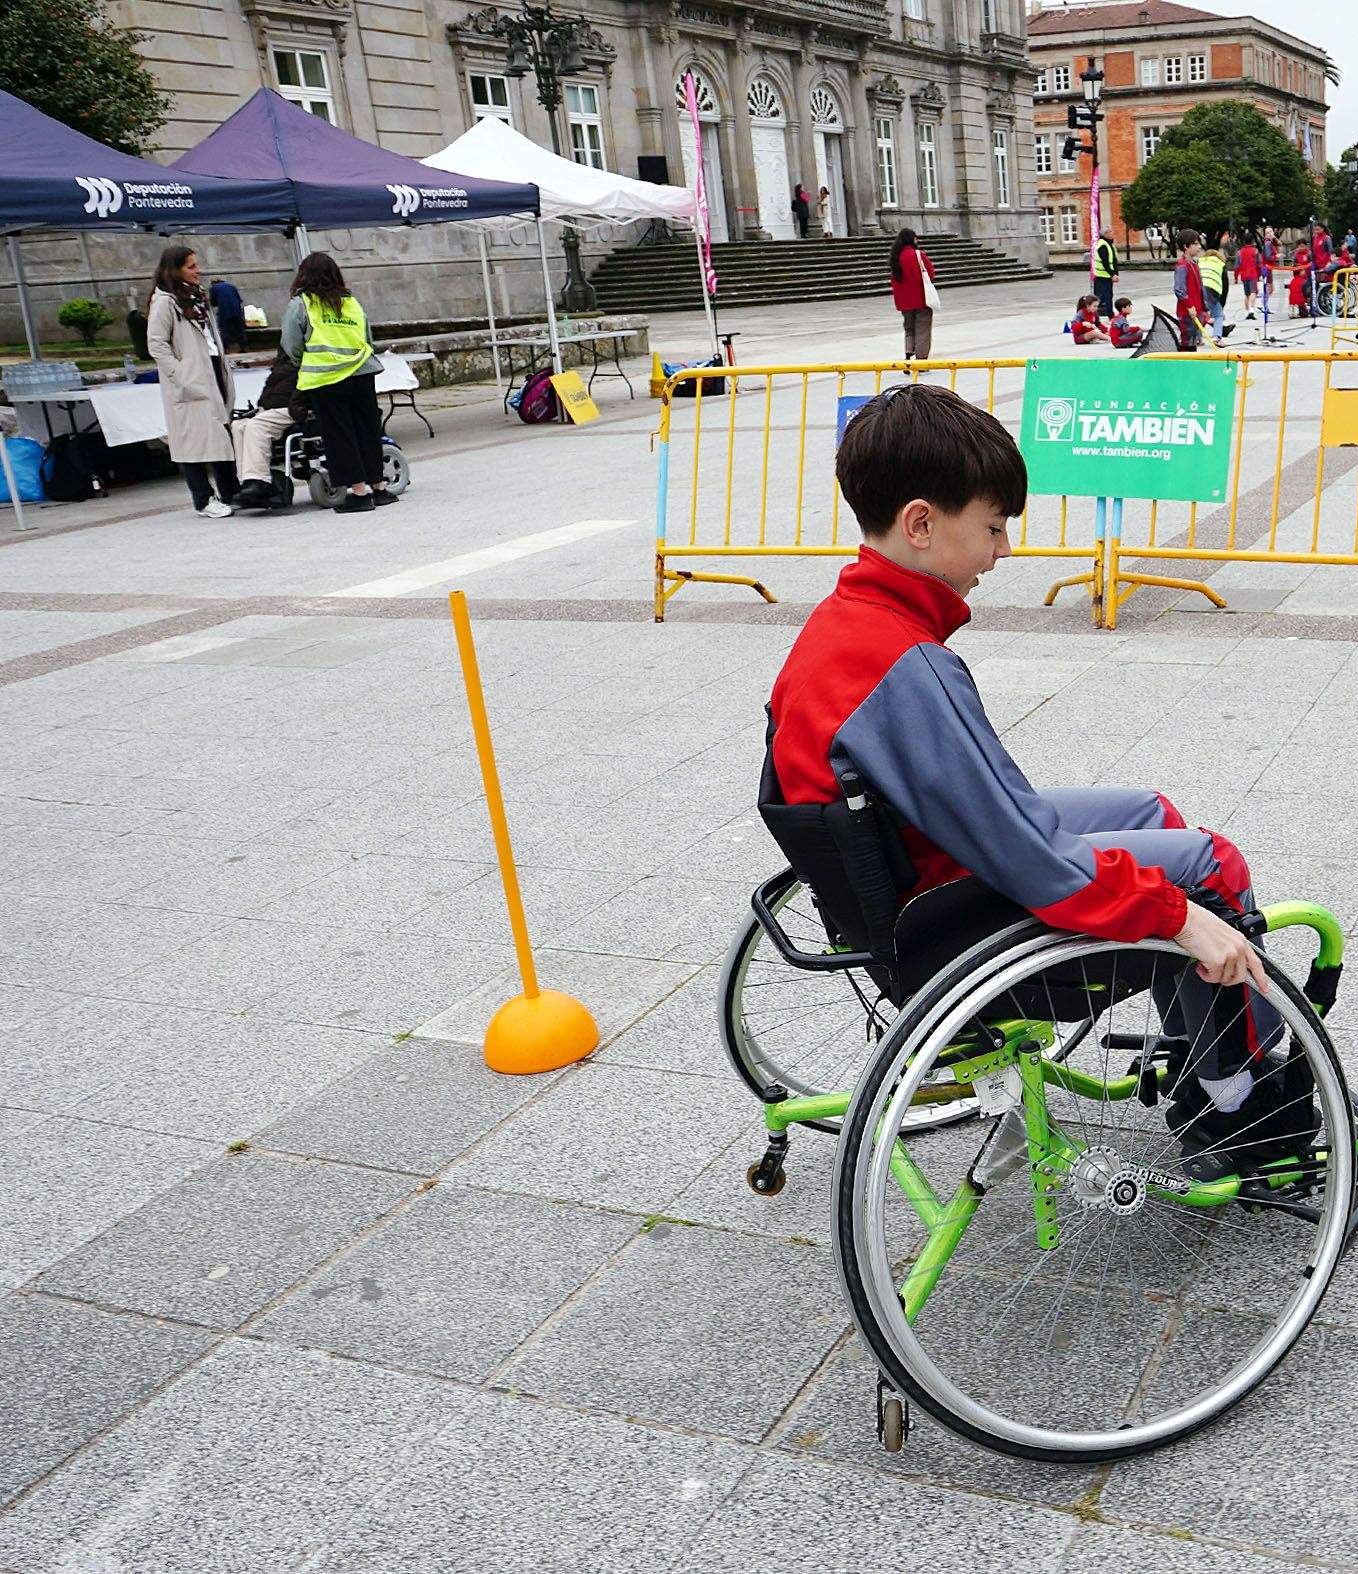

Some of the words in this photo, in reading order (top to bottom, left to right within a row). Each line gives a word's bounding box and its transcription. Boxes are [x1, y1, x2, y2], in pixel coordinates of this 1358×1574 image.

[123, 182, 192, 197] Deputación
[128, 196, 194, 208] Pontevedra
[423, 198, 468, 208] Pontevedra
[1080, 401, 1216, 411] FUNDACIÓN
[1072, 446, 1171, 460] www.tambien.org
